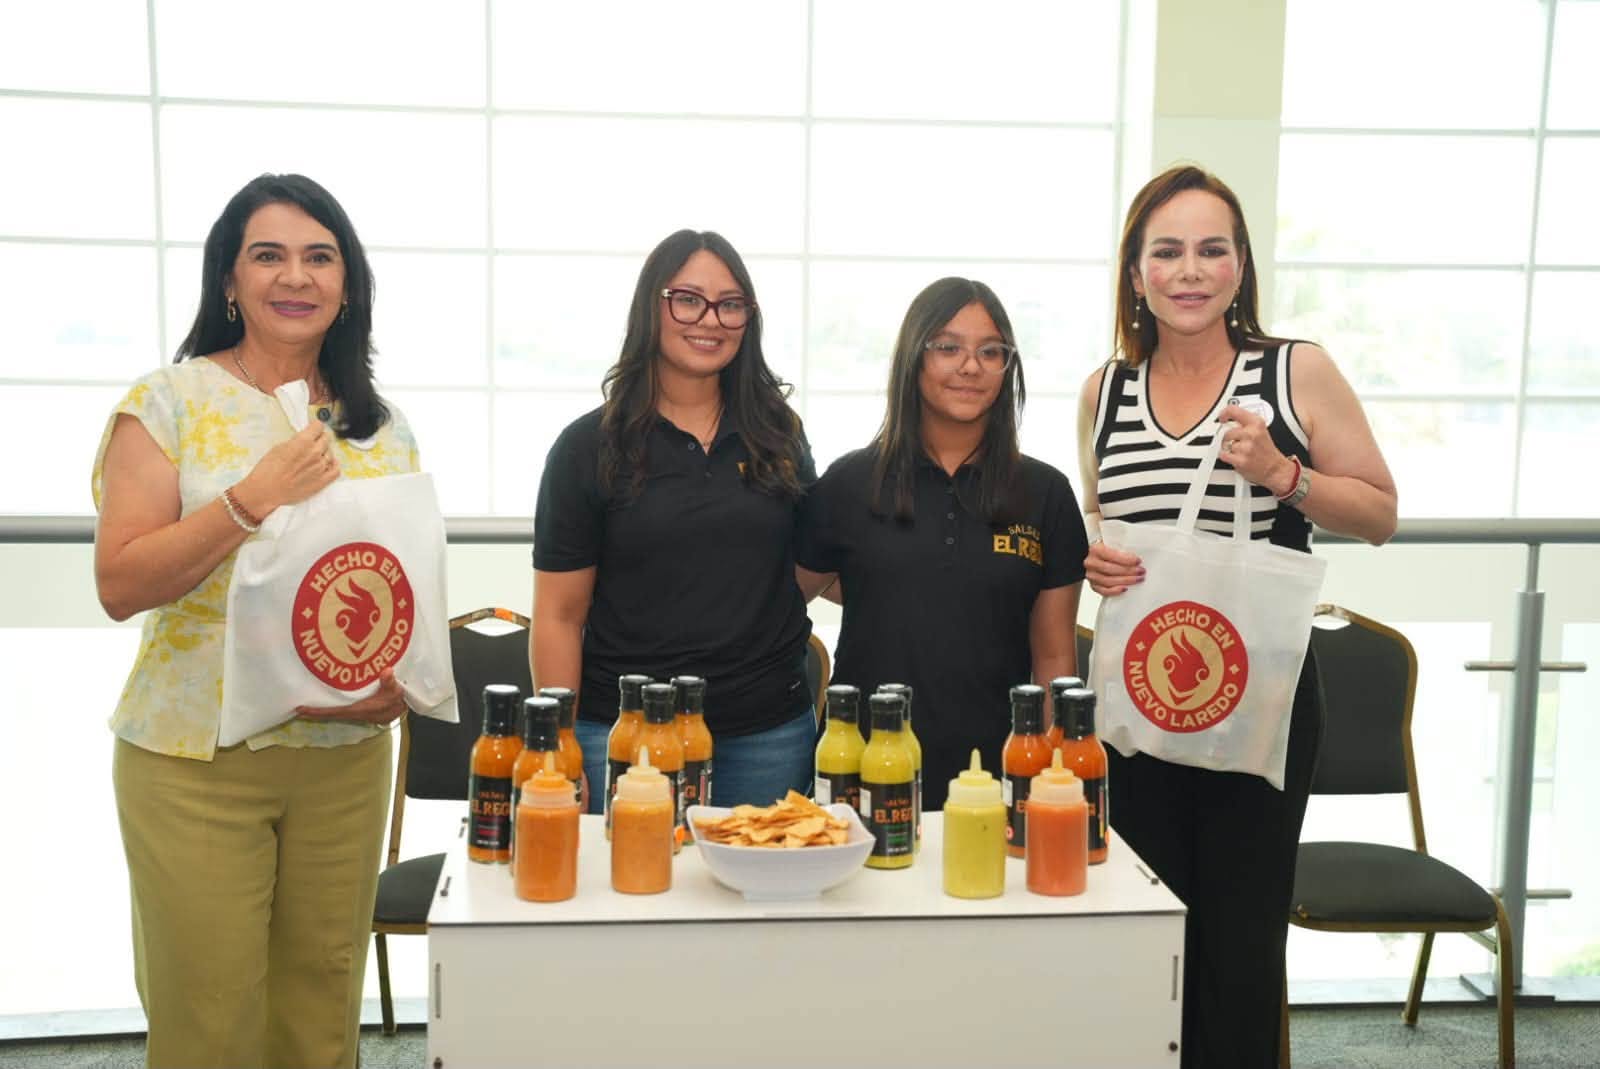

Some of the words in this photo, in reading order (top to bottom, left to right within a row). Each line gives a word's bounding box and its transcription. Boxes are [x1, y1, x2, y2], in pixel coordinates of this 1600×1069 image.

[993, 534, 1017, 554] EL
[310, 551, 377, 593] HECHO
[380, 557, 403, 586] EN
[1150, 608, 1211, 635] HECHO
[1210, 624, 1236, 650] EN
[300, 629, 353, 684] NUEVO
[354, 618, 409, 684] LAREDO
[1128, 660, 1168, 722] NUEVO
[1169, 683, 1239, 729] LAREDO
[874, 808, 891, 824] EL
